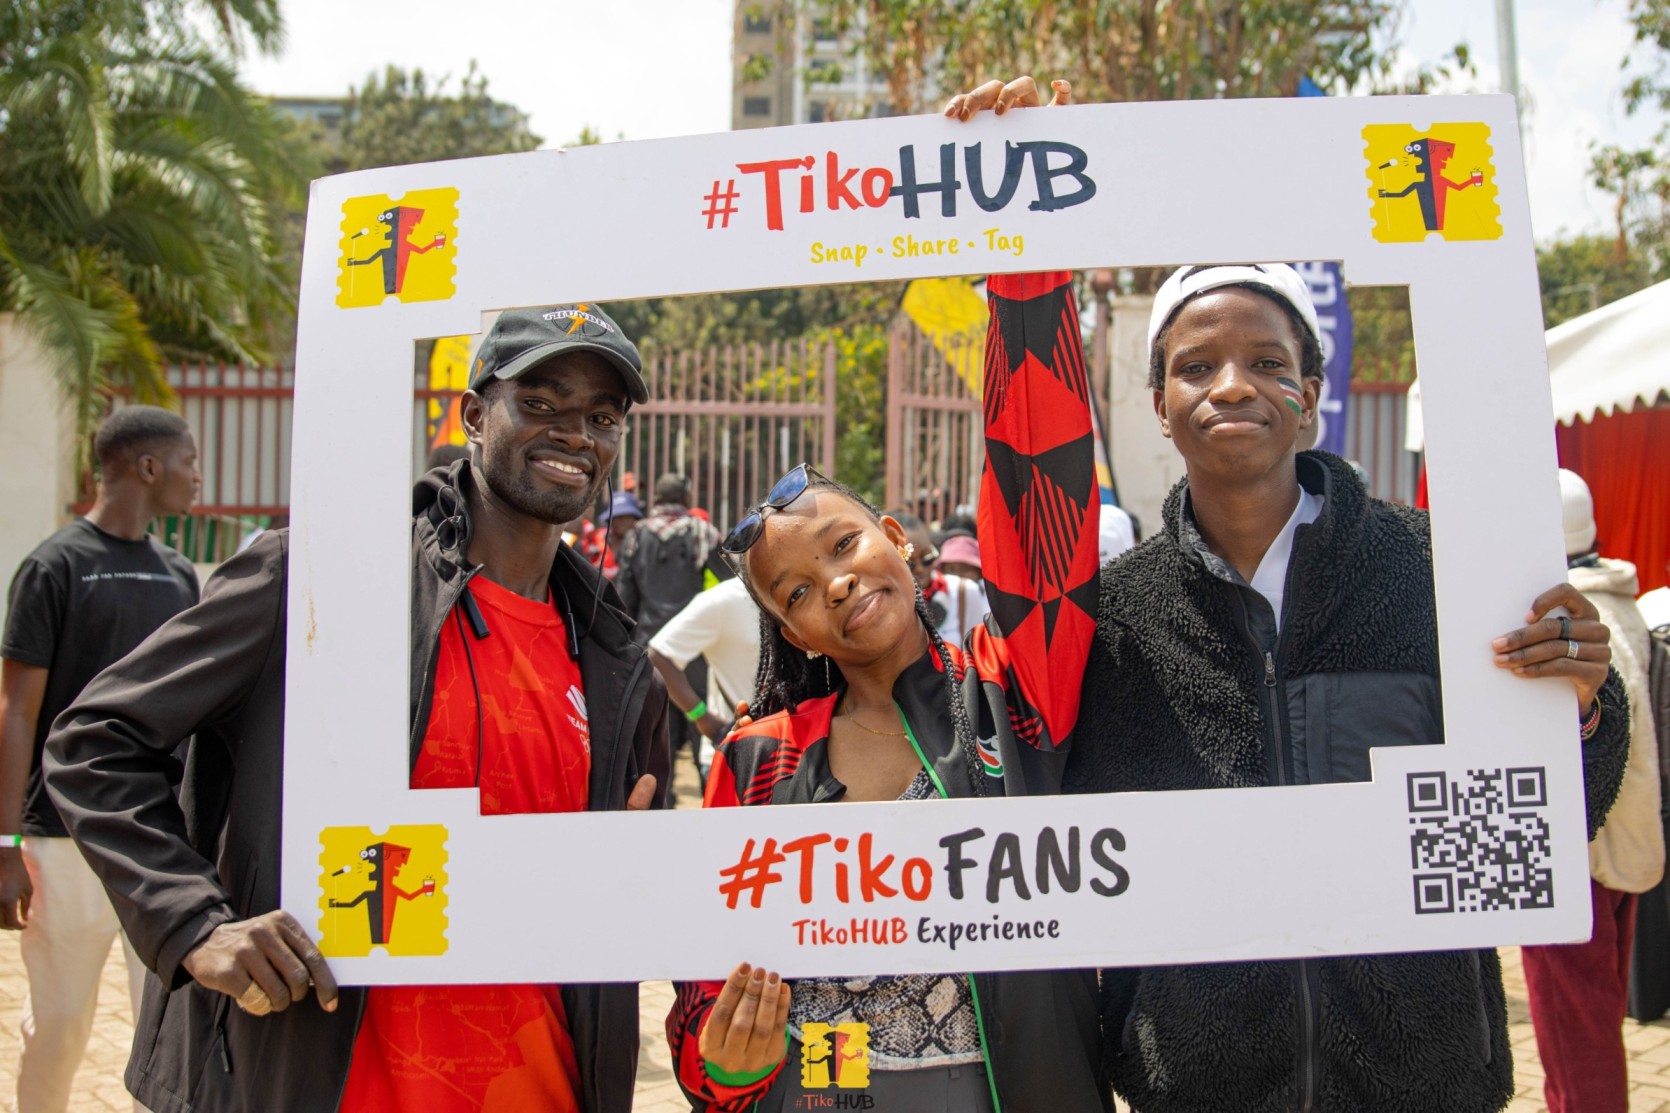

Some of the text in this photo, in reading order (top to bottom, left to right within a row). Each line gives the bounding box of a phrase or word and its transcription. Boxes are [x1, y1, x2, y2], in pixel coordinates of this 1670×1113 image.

[702, 140, 1097, 231] #TikoHUB
[810, 228, 1025, 267] Snap Share Tag
[566, 714, 587, 733] TEAM
[719, 826, 1130, 910] #TikoFANS
[792, 915, 1060, 950] TikoHUB Experience
